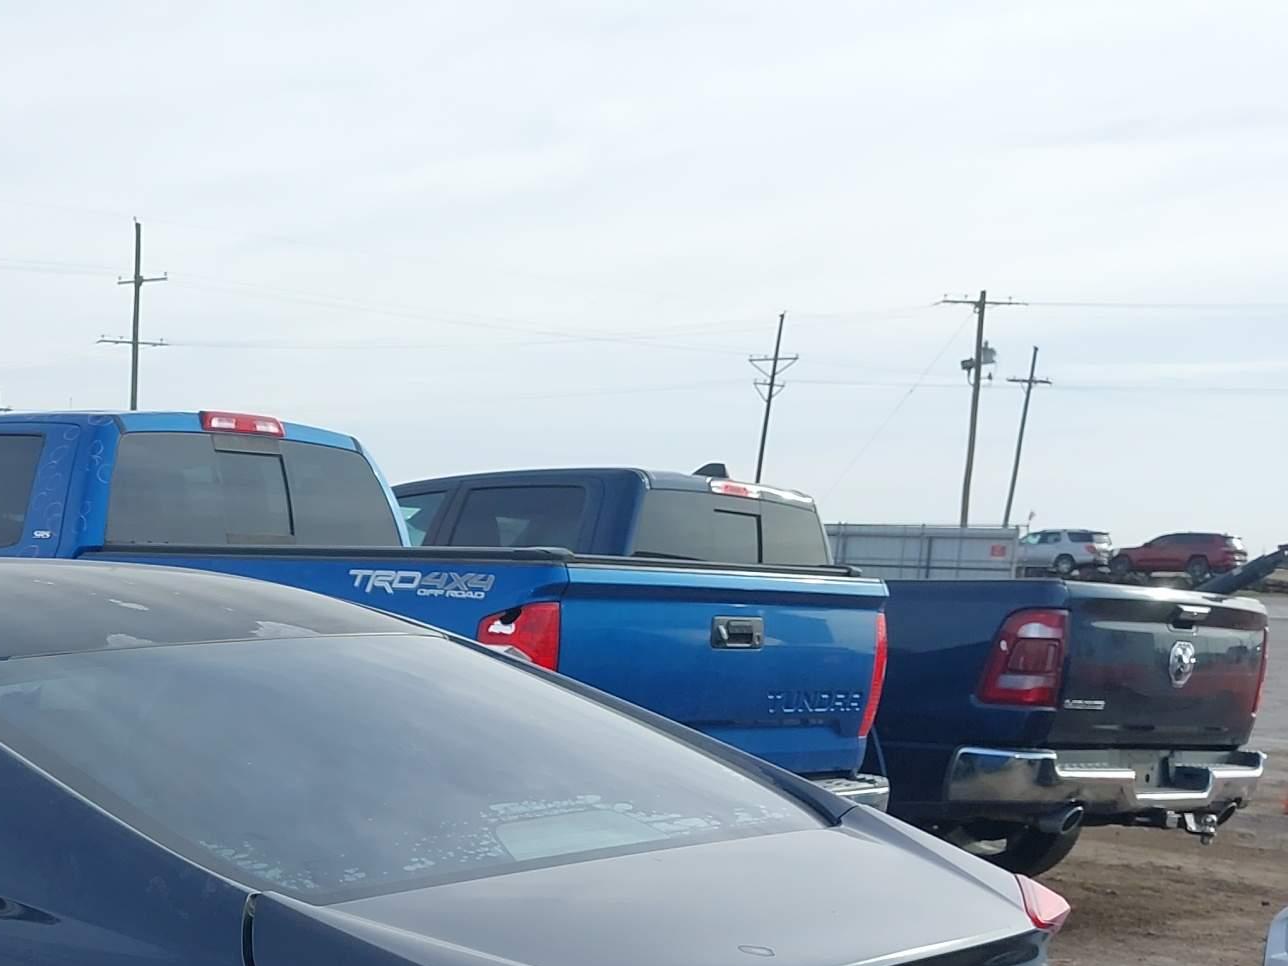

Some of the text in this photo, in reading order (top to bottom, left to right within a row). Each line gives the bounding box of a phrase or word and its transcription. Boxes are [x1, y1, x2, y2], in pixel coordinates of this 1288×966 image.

[349, 569, 422, 595] TRD
[417, 589, 486, 600] OFF ROAD
[767, 690, 861, 713] TUNDRA
